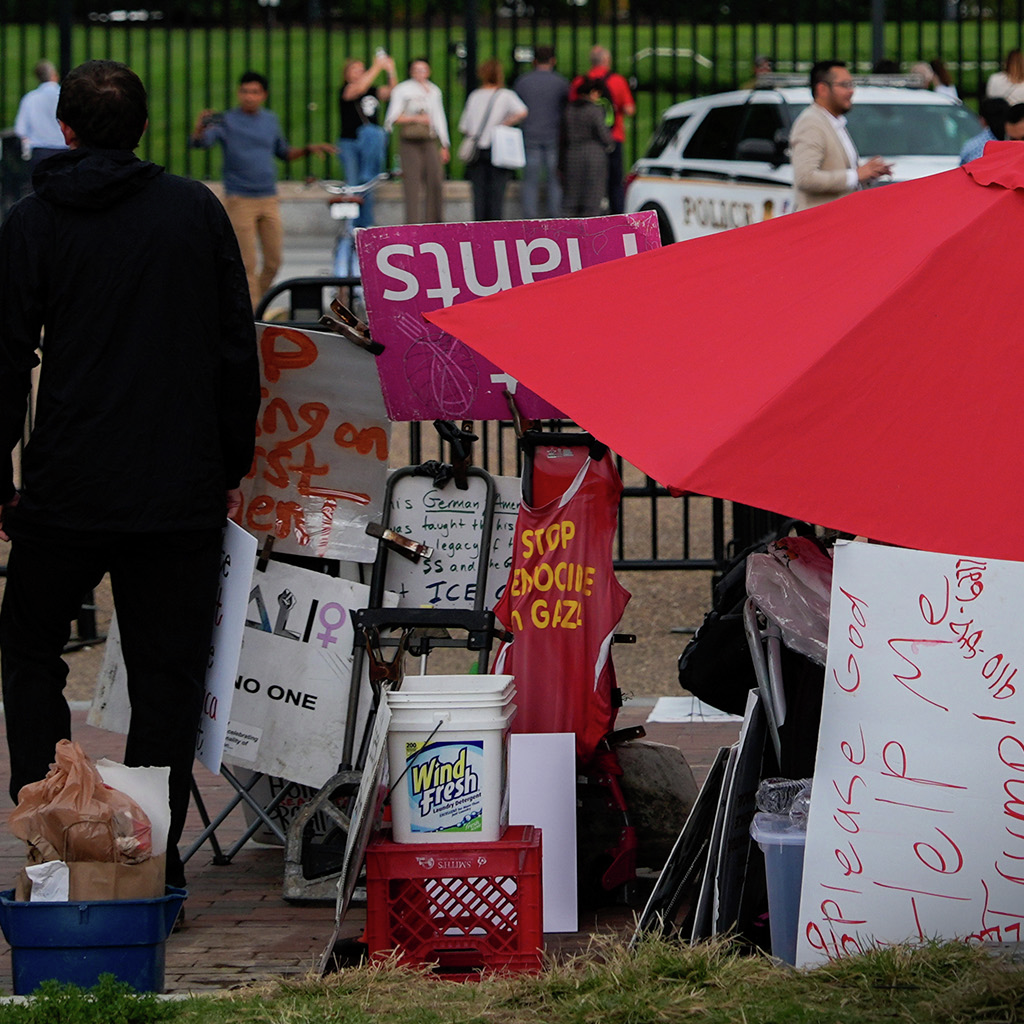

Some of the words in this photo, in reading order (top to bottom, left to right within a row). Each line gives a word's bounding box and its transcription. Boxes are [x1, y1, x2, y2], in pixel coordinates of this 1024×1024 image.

[334, 423, 388, 461] on
[422, 489, 480, 509] German
[422, 516, 466, 537] taught
[521, 520, 575, 559] STOP
[436, 538, 479, 560] legacy
[449, 561, 476, 572] and
[425, 580, 477, 604] ICE
[511, 561, 596, 597] ENOCIDE
[832, 586, 869, 693] God
[888, 574, 954, 713] Me
[267, 685, 318, 711] ONE
[411, 747, 467, 796] Wind
[419, 765, 479, 817] Fresh
